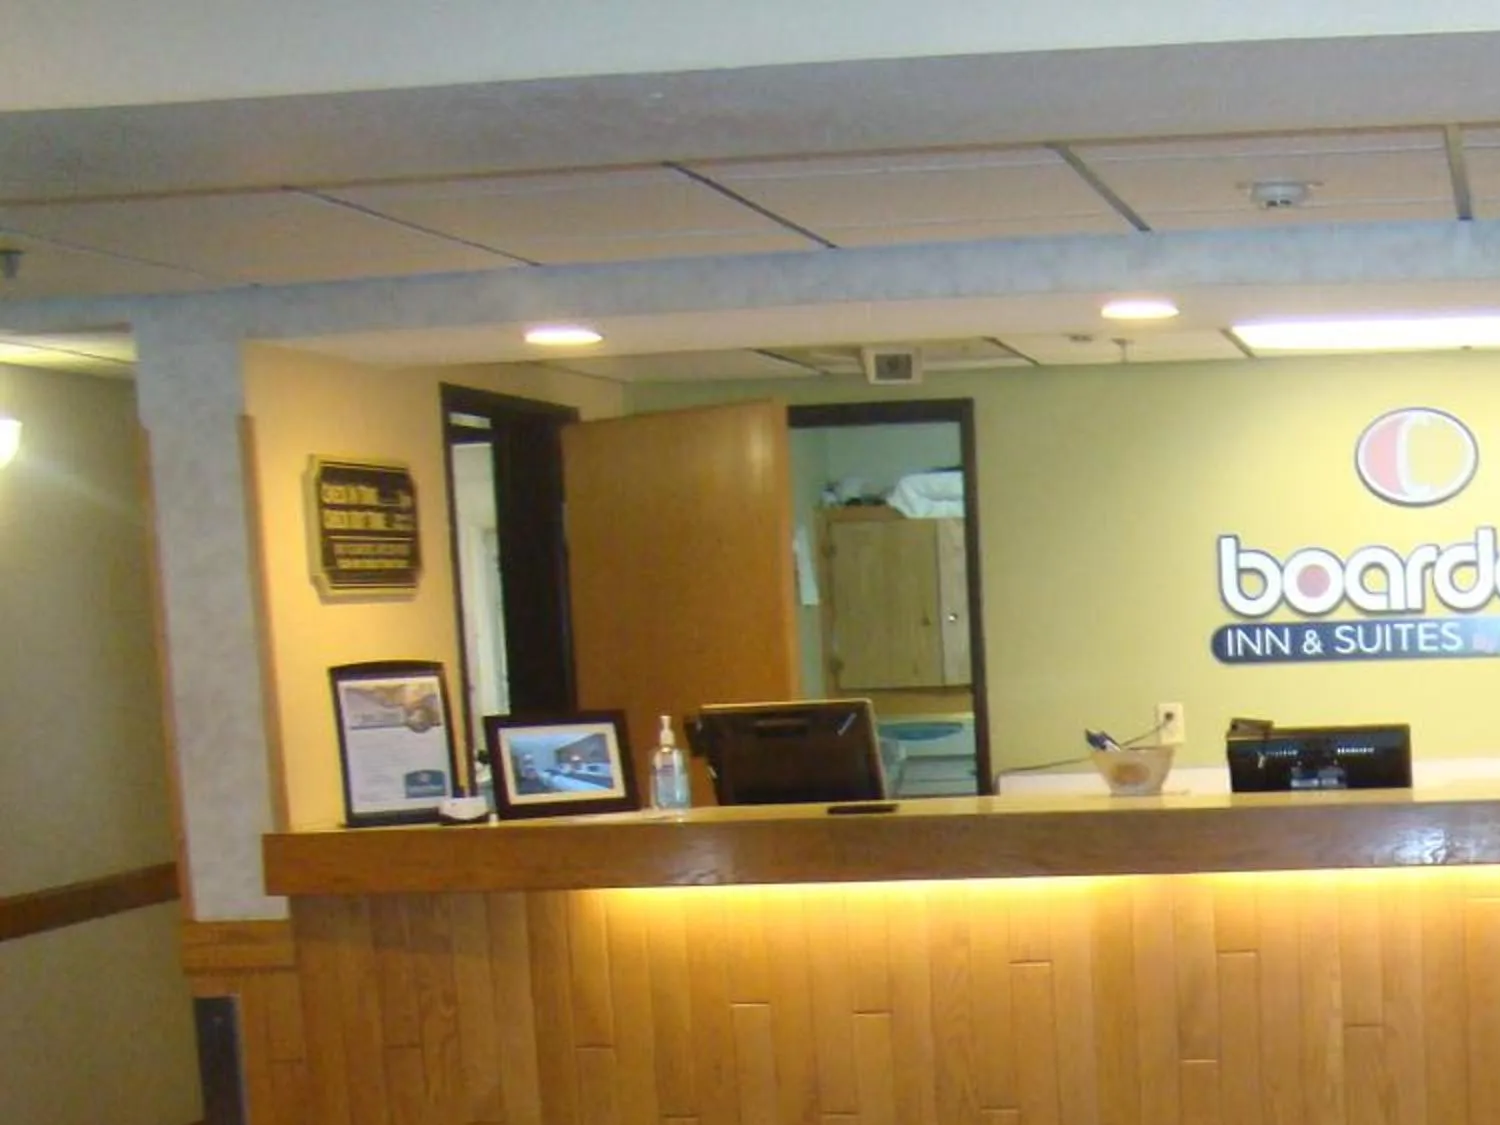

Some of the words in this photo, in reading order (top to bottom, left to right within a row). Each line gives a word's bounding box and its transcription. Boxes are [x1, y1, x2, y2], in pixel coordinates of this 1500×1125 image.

[1226, 627, 1291, 657] INN
[1302, 629, 1324, 655] &
[1335, 622, 1463, 654] SUITES
